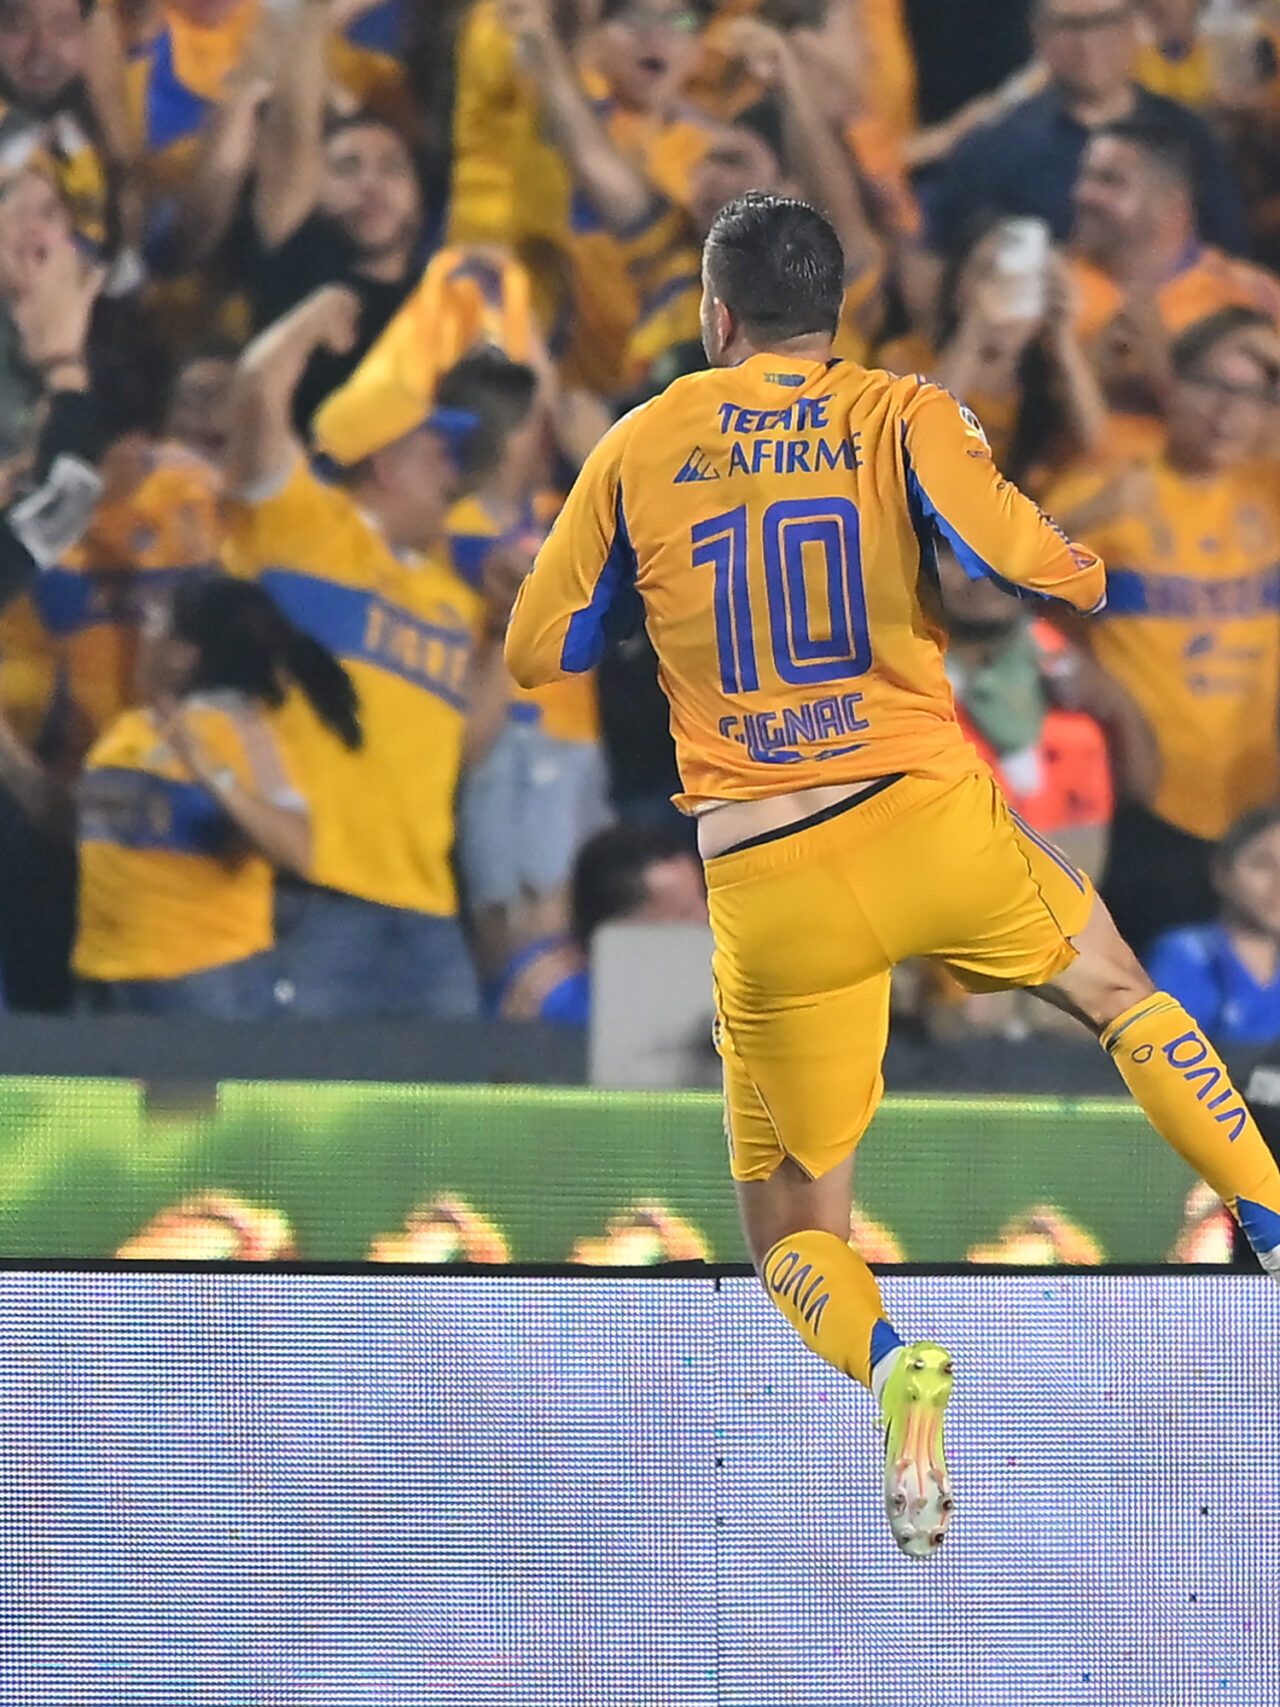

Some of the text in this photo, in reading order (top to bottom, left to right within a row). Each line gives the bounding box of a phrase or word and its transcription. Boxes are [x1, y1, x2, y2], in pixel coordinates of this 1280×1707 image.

[718, 394, 836, 434] TECATE
[728, 431, 863, 477] AFIRME
[691, 496, 873, 694] 10
[719, 692, 869, 750] GIGNAC
[1162, 1031, 1247, 1142] viva
